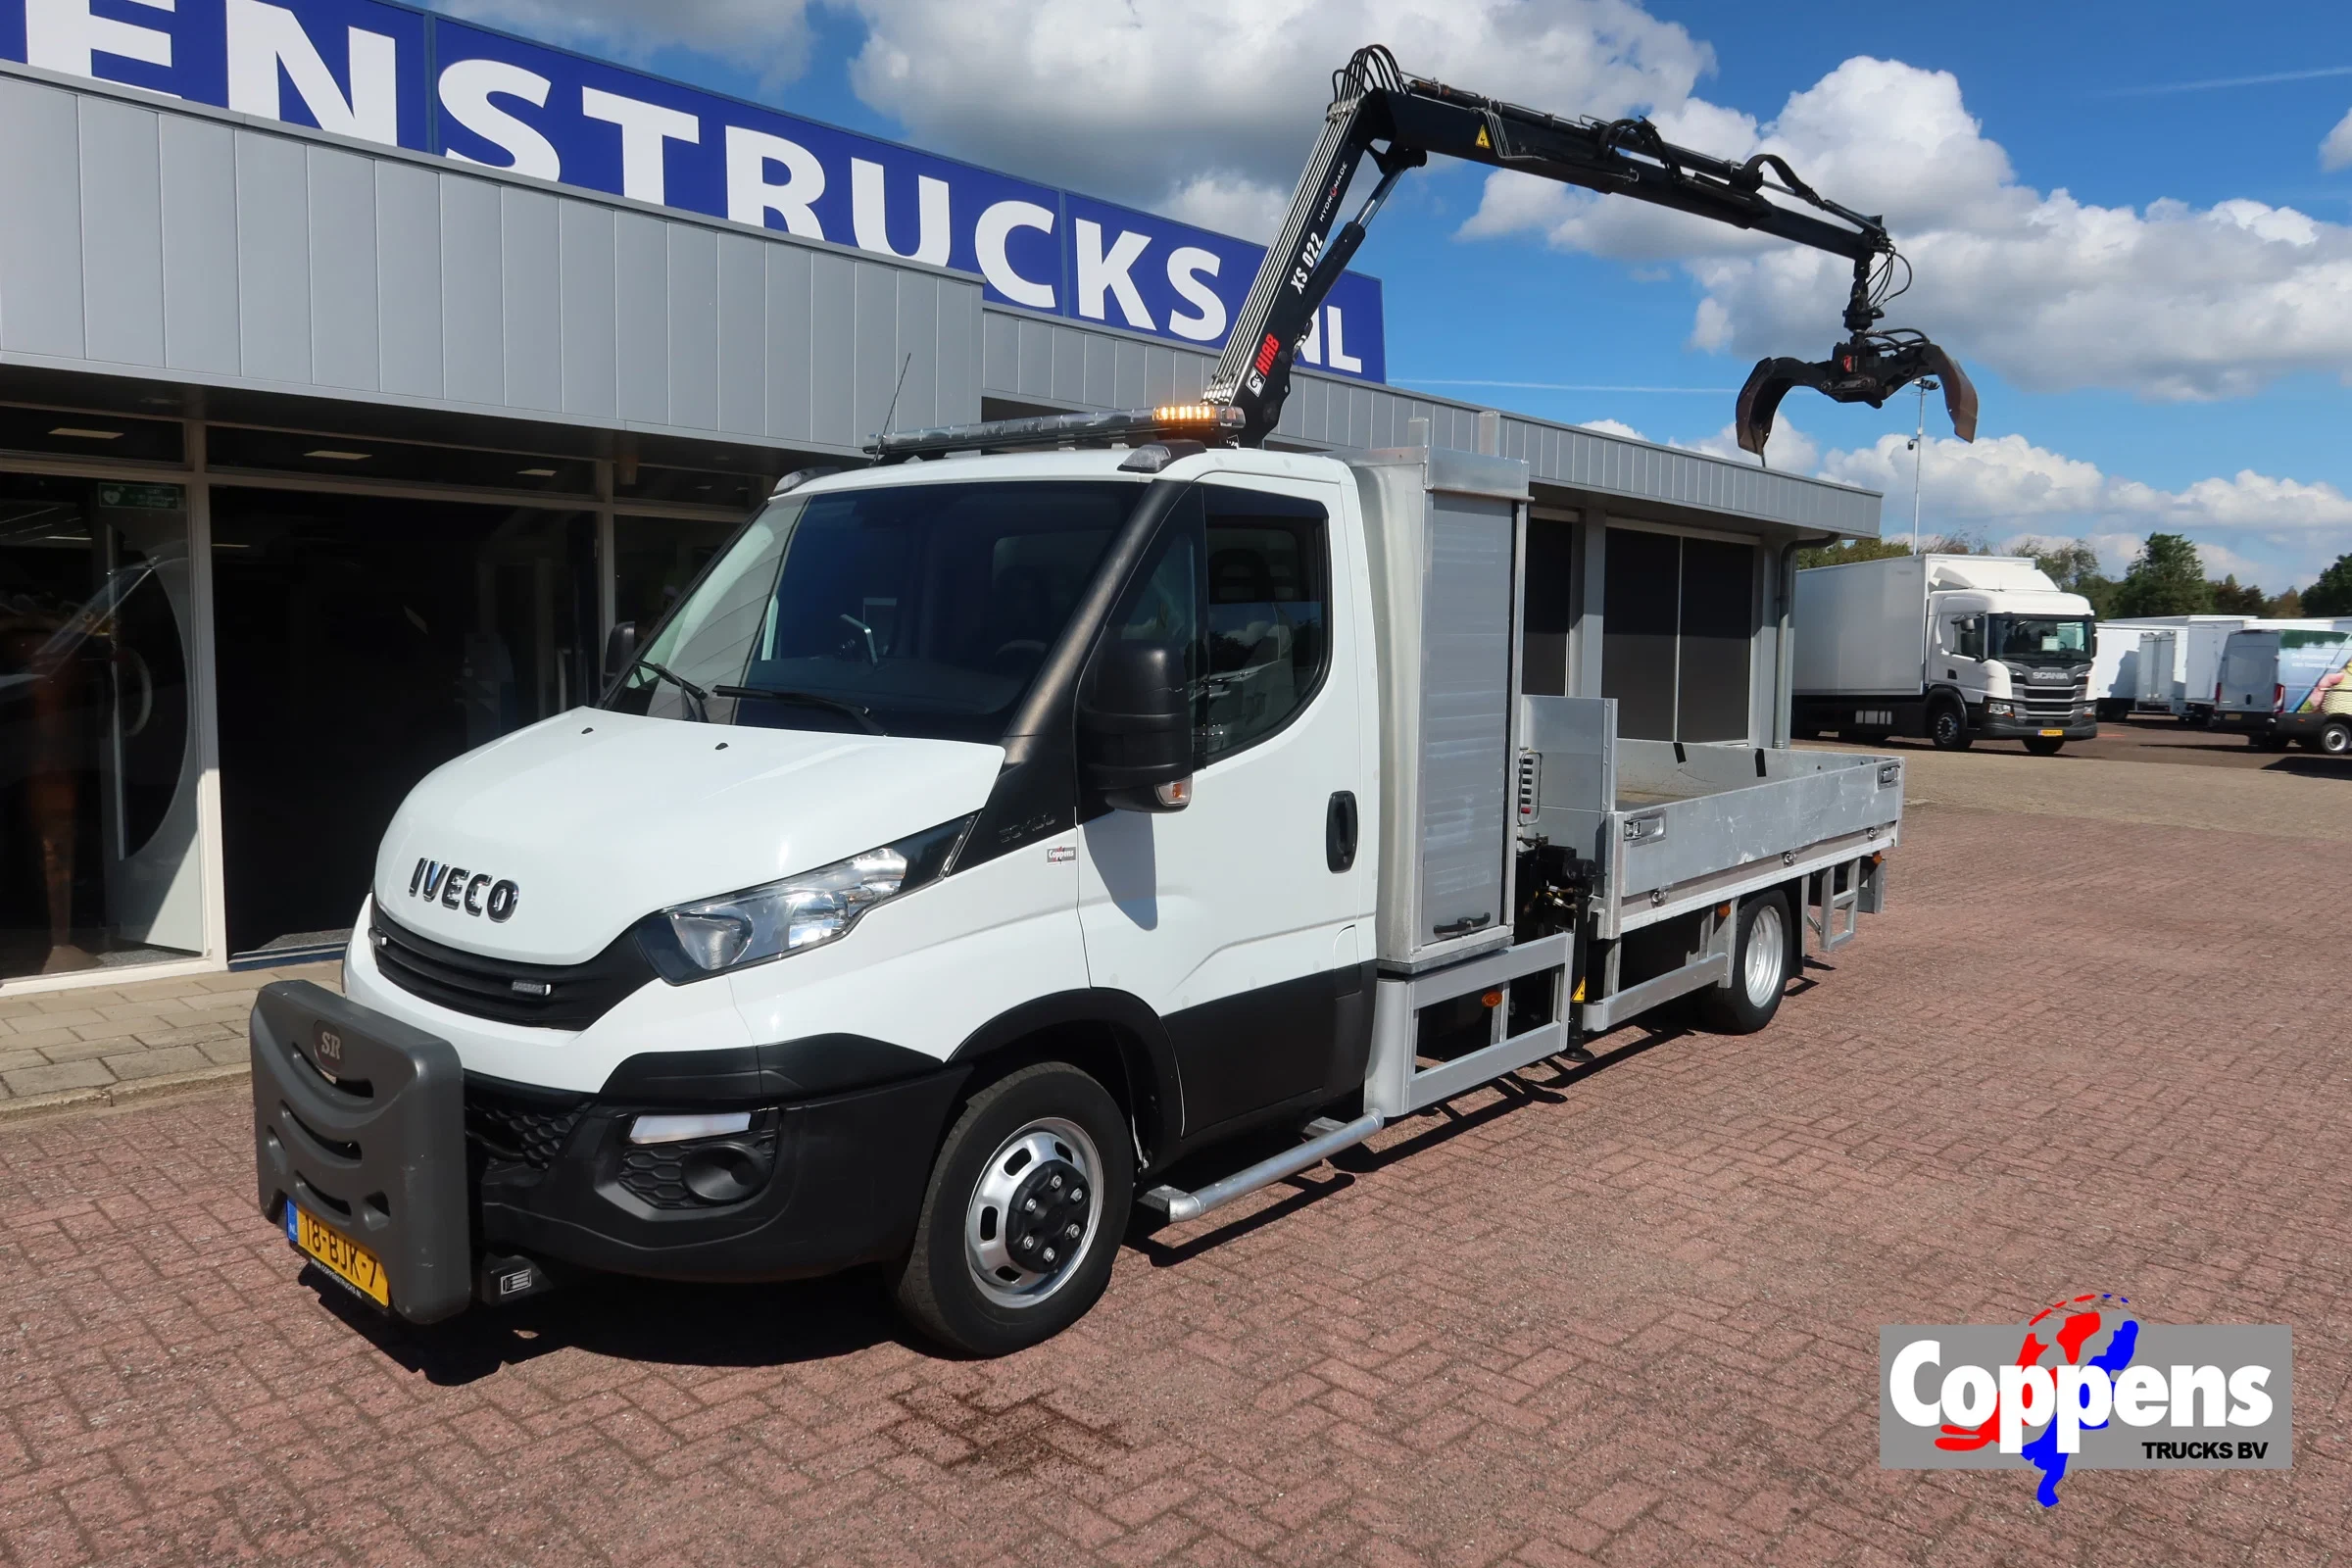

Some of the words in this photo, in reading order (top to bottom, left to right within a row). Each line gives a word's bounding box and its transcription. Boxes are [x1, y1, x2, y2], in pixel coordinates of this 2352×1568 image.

[1290, 267, 1308, 295] XS
[1301, 231, 1323, 269] 022
[1254, 332, 1280, 376] HIAB
[2032, 671, 2070, 681] SCANIA
[1049, 850, 1074, 860] Coppens
[408, 857, 520, 924] IVECO
[320, 1031, 342, 1059] SR
[305, 1214, 378, 1289] 18-BJK-7
